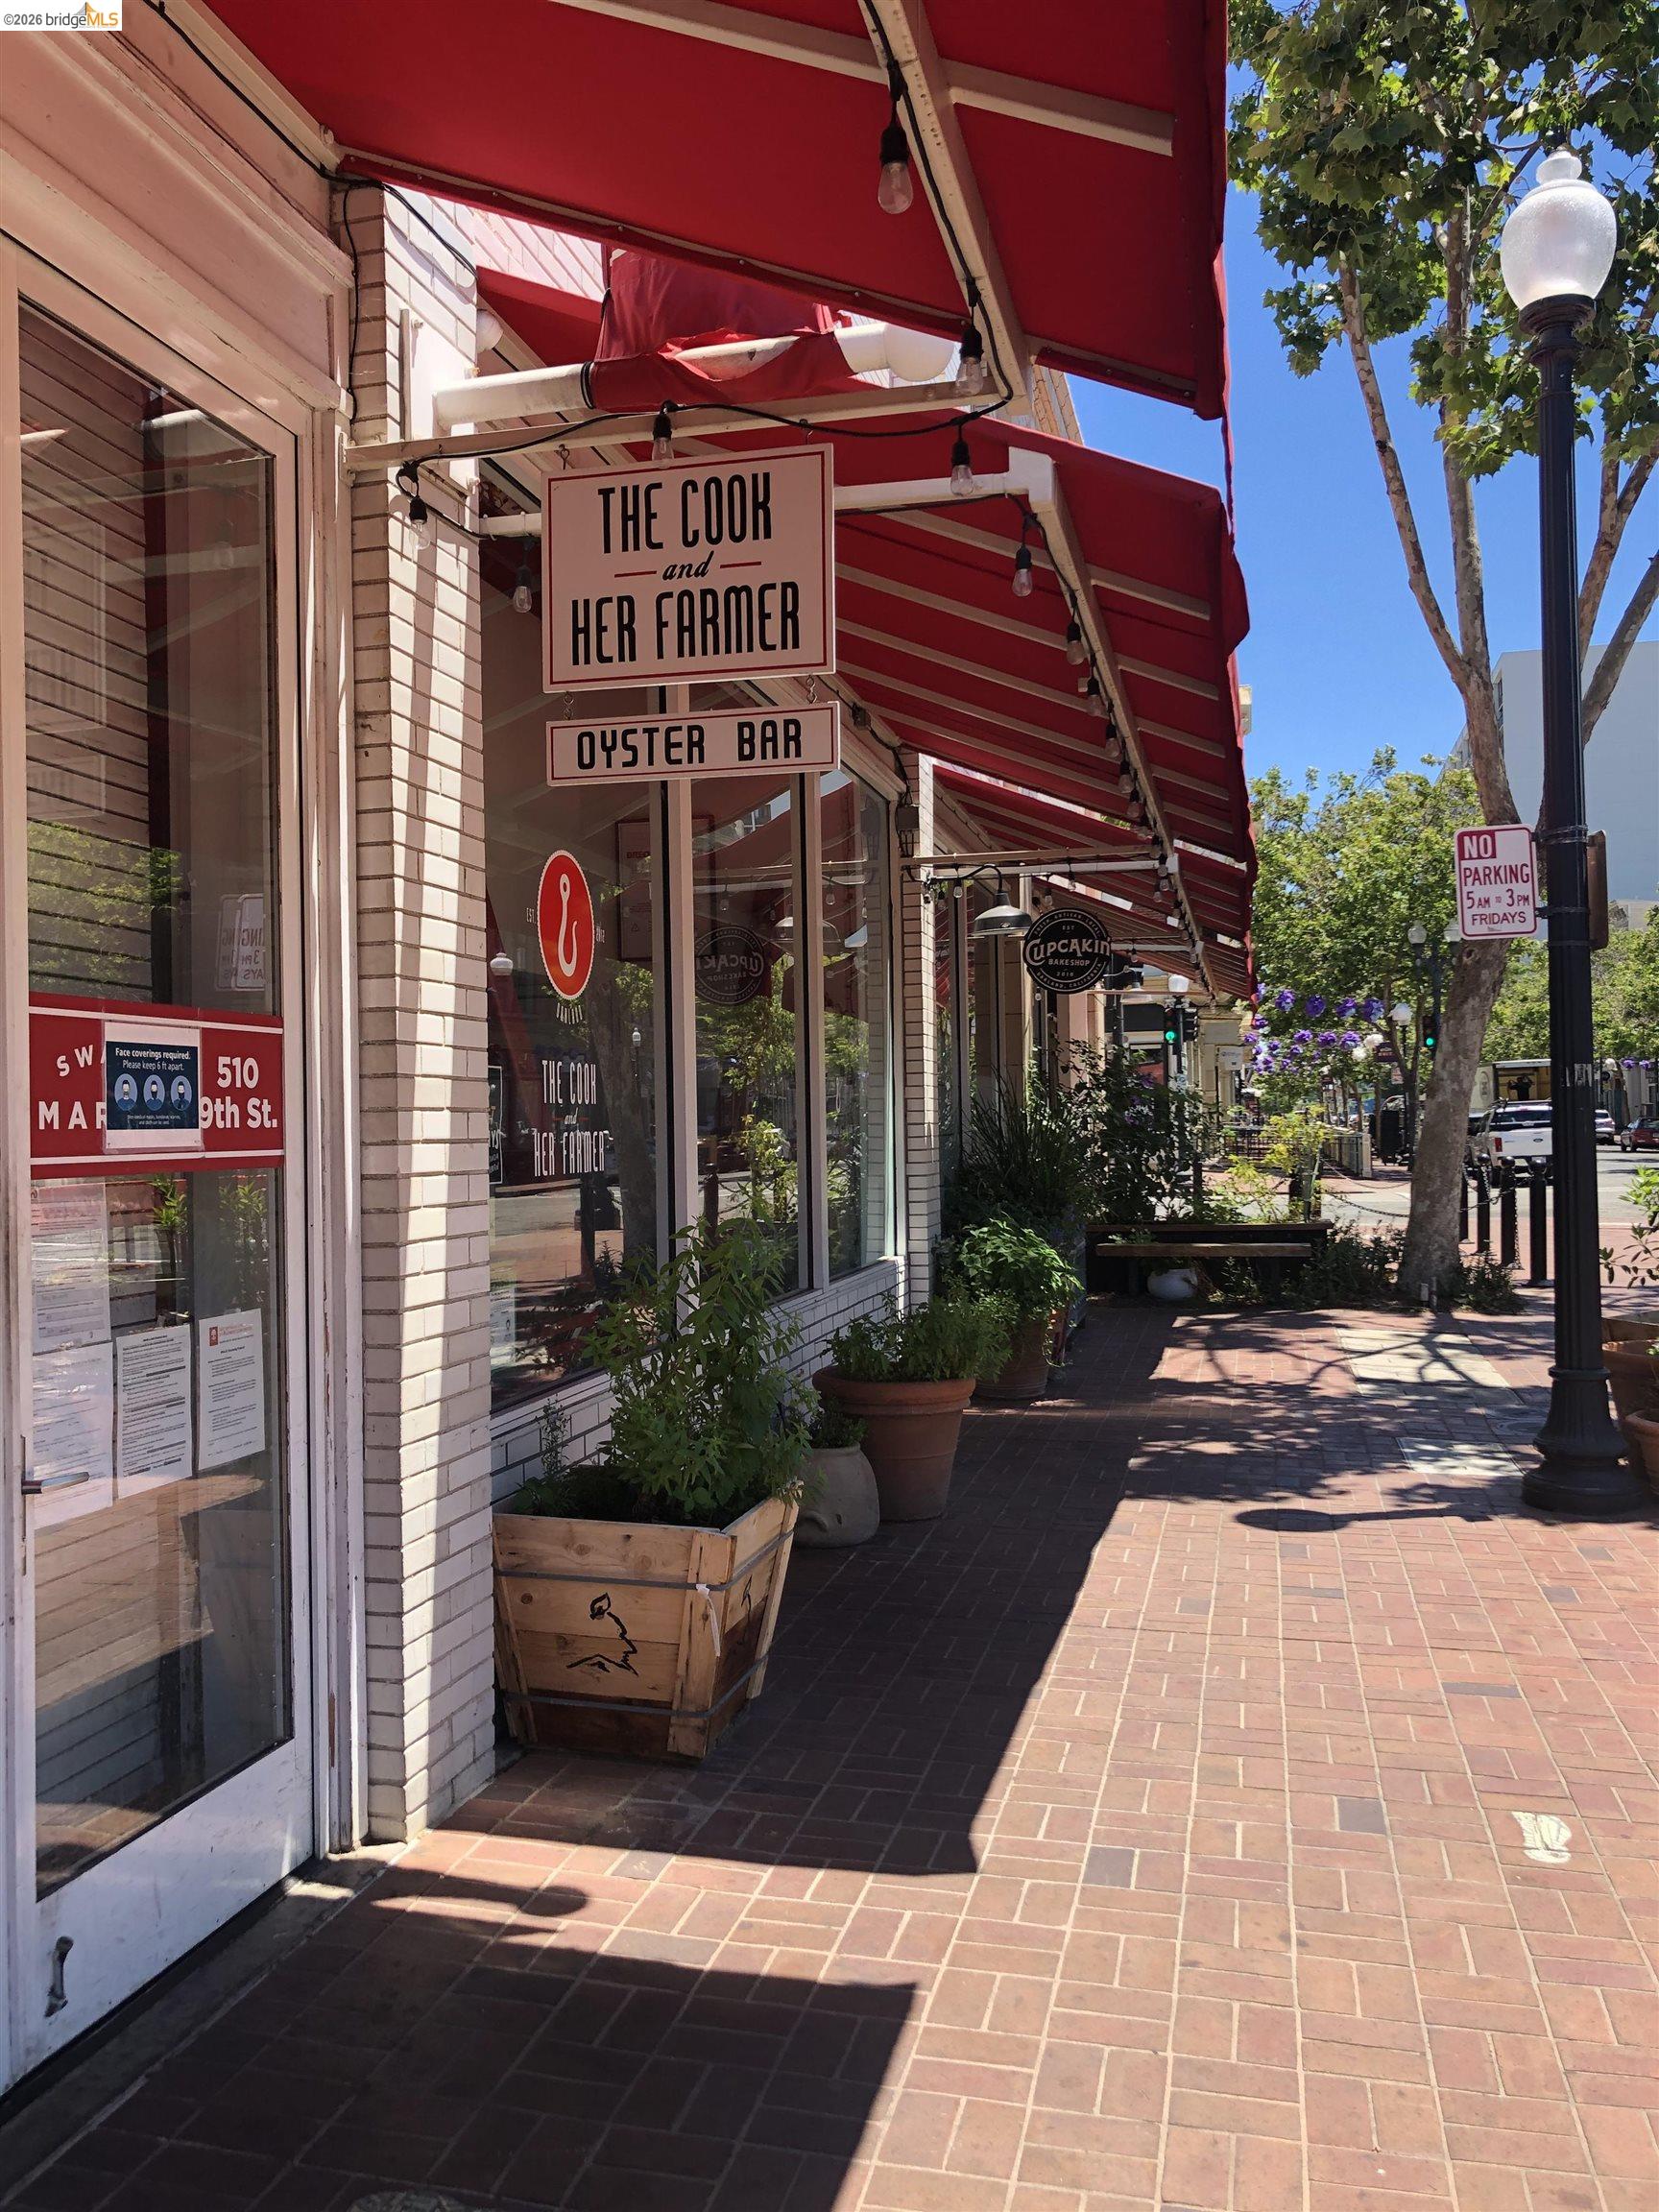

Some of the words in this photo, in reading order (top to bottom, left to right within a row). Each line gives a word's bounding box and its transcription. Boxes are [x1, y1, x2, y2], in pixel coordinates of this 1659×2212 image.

[597, 482, 663, 554] THE
[681, 471, 772, 548] COOK
[661, 550, 714, 581] and
[571, 594, 637, 666] HER
[655, 581, 800, 660] FARMER
[577, 723, 706, 770] OYSTER
[736, 718, 802, 761] BAR
[1463, 834, 1493, 859] NO
[1463, 863, 1530, 886] PARKING
[1466, 891, 1475, 909] 5
[1477, 897, 1491, 908] AM
[1505, 888, 1515, 907] 3
[1517, 895, 1530, 906] PM
[1471, 911, 1527, 926] FRIDAYS
[1047, 958, 1091, 967] BAKESHOP
[115, 1047, 131, 1056] Face
[132, 1048, 162, 1060] coverings
[162, 1050, 191, 1061] required.
[122, 1059, 141, 1070] Please
[142, 1060, 156, 1070] keep
[161, 1061, 167, 1070] ft
[167, 1062, 185, 1071] apart.
[217, 1056, 259, 1089] 510
[541, 1060, 563, 1104] THE
[569, 1062, 597, 1105] COOK
[200, 1095, 240, 1129] 9th
[246, 1096, 277, 1129] St.
[564, 1107, 578, 1125] and
[534, 1131, 555, 1177] HER
[563, 1130, 605, 1174] FARMER
